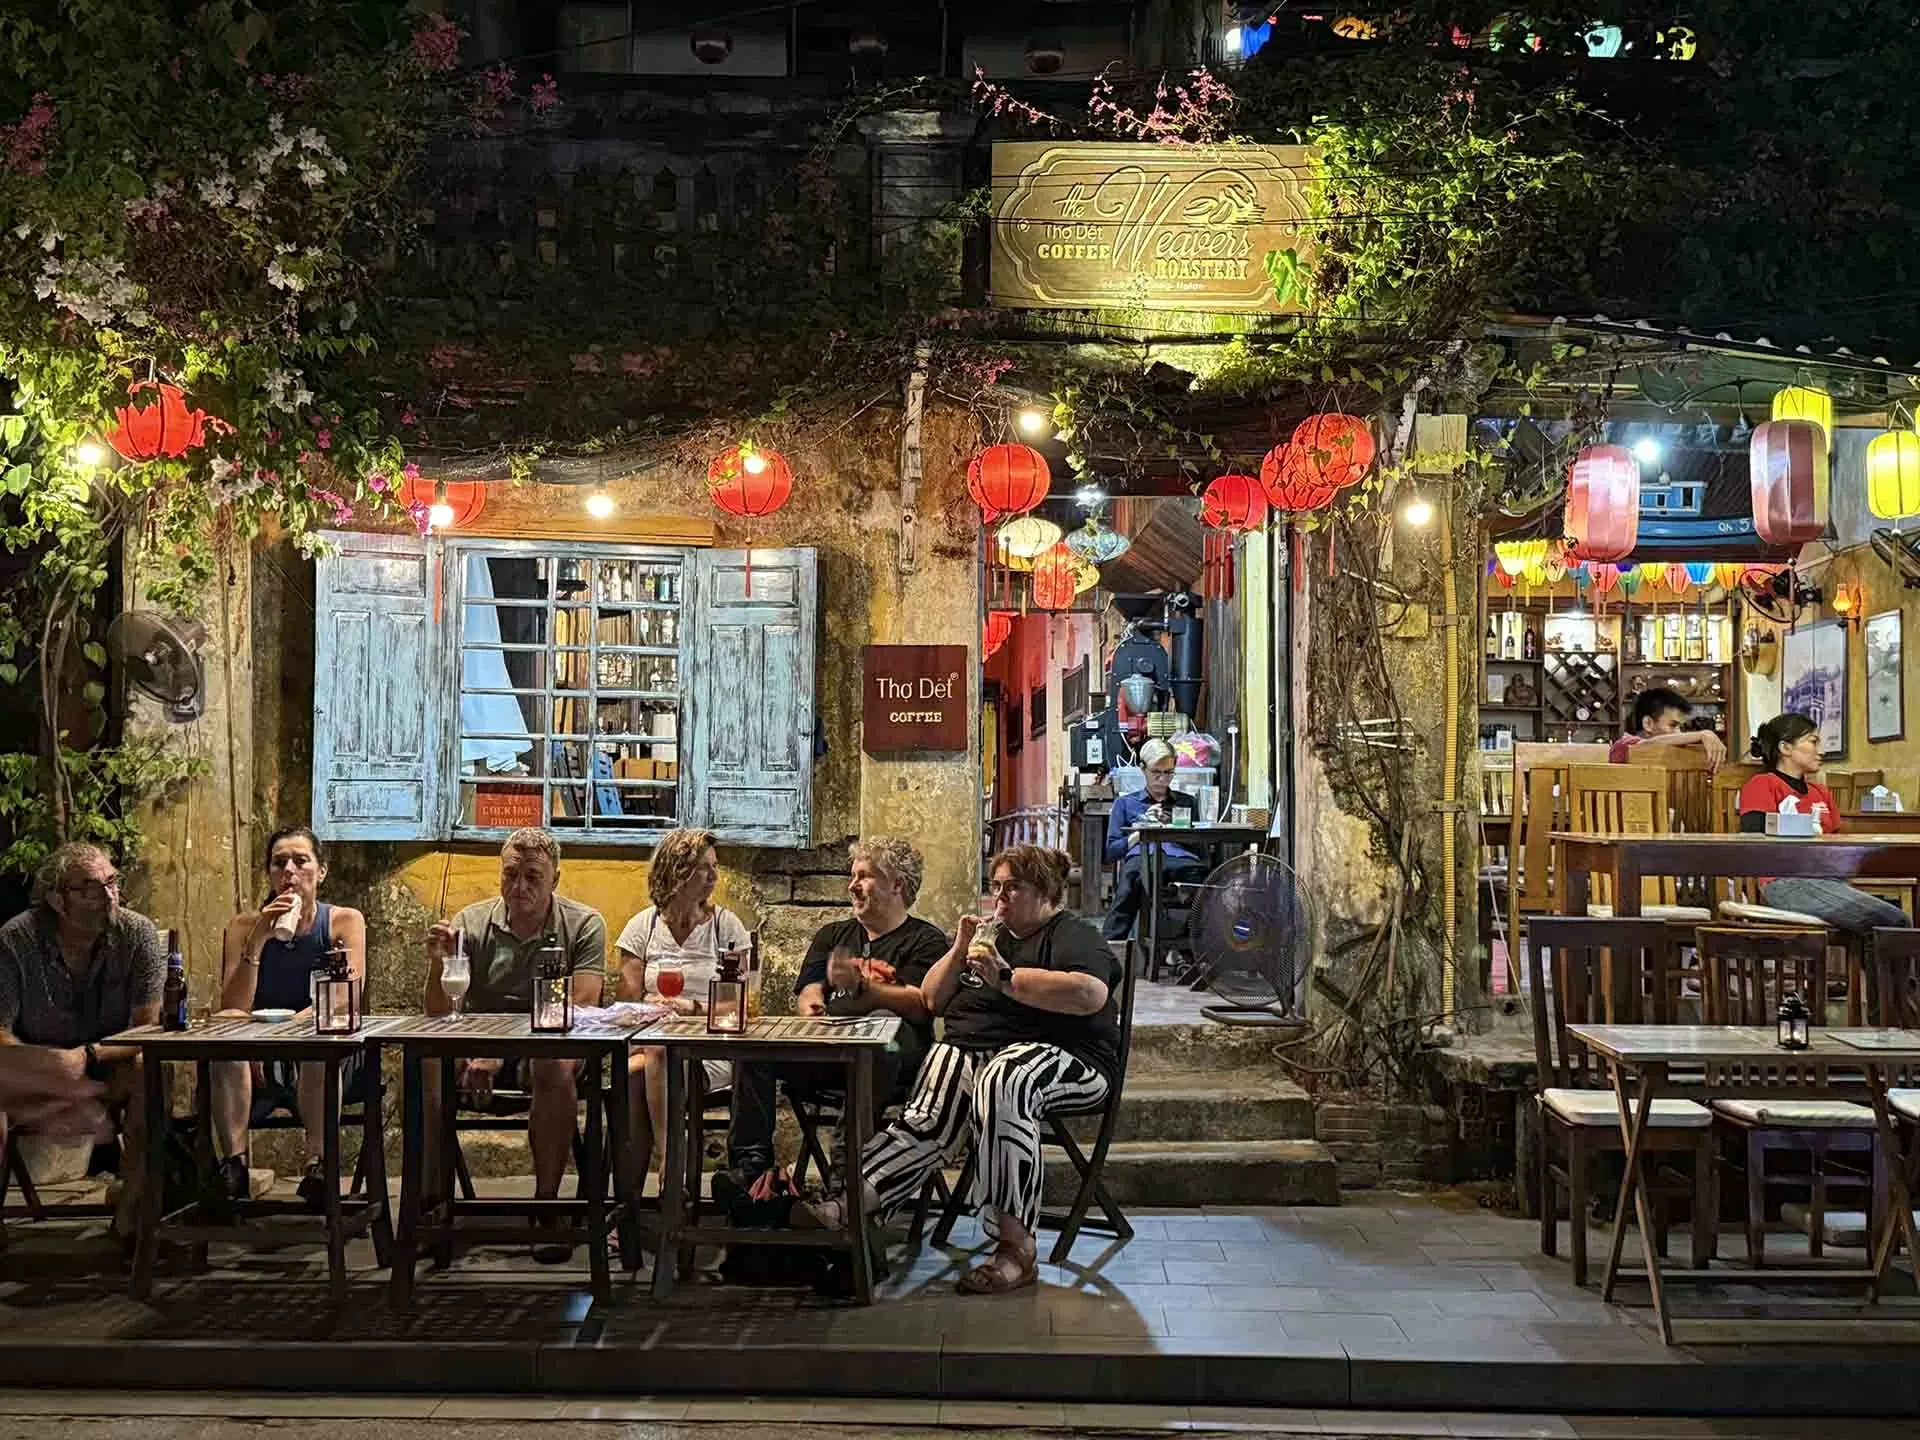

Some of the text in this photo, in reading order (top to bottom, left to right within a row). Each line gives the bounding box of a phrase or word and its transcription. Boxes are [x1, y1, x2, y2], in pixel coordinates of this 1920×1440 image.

[1053, 165, 1257, 273] the Weavers
[1038, 243, 1112, 260] COFFEE
[1153, 258, 1250, 280] ROASTERY
[876, 677, 912, 702] Thợ
[889, 711, 943, 723] COFFEE
